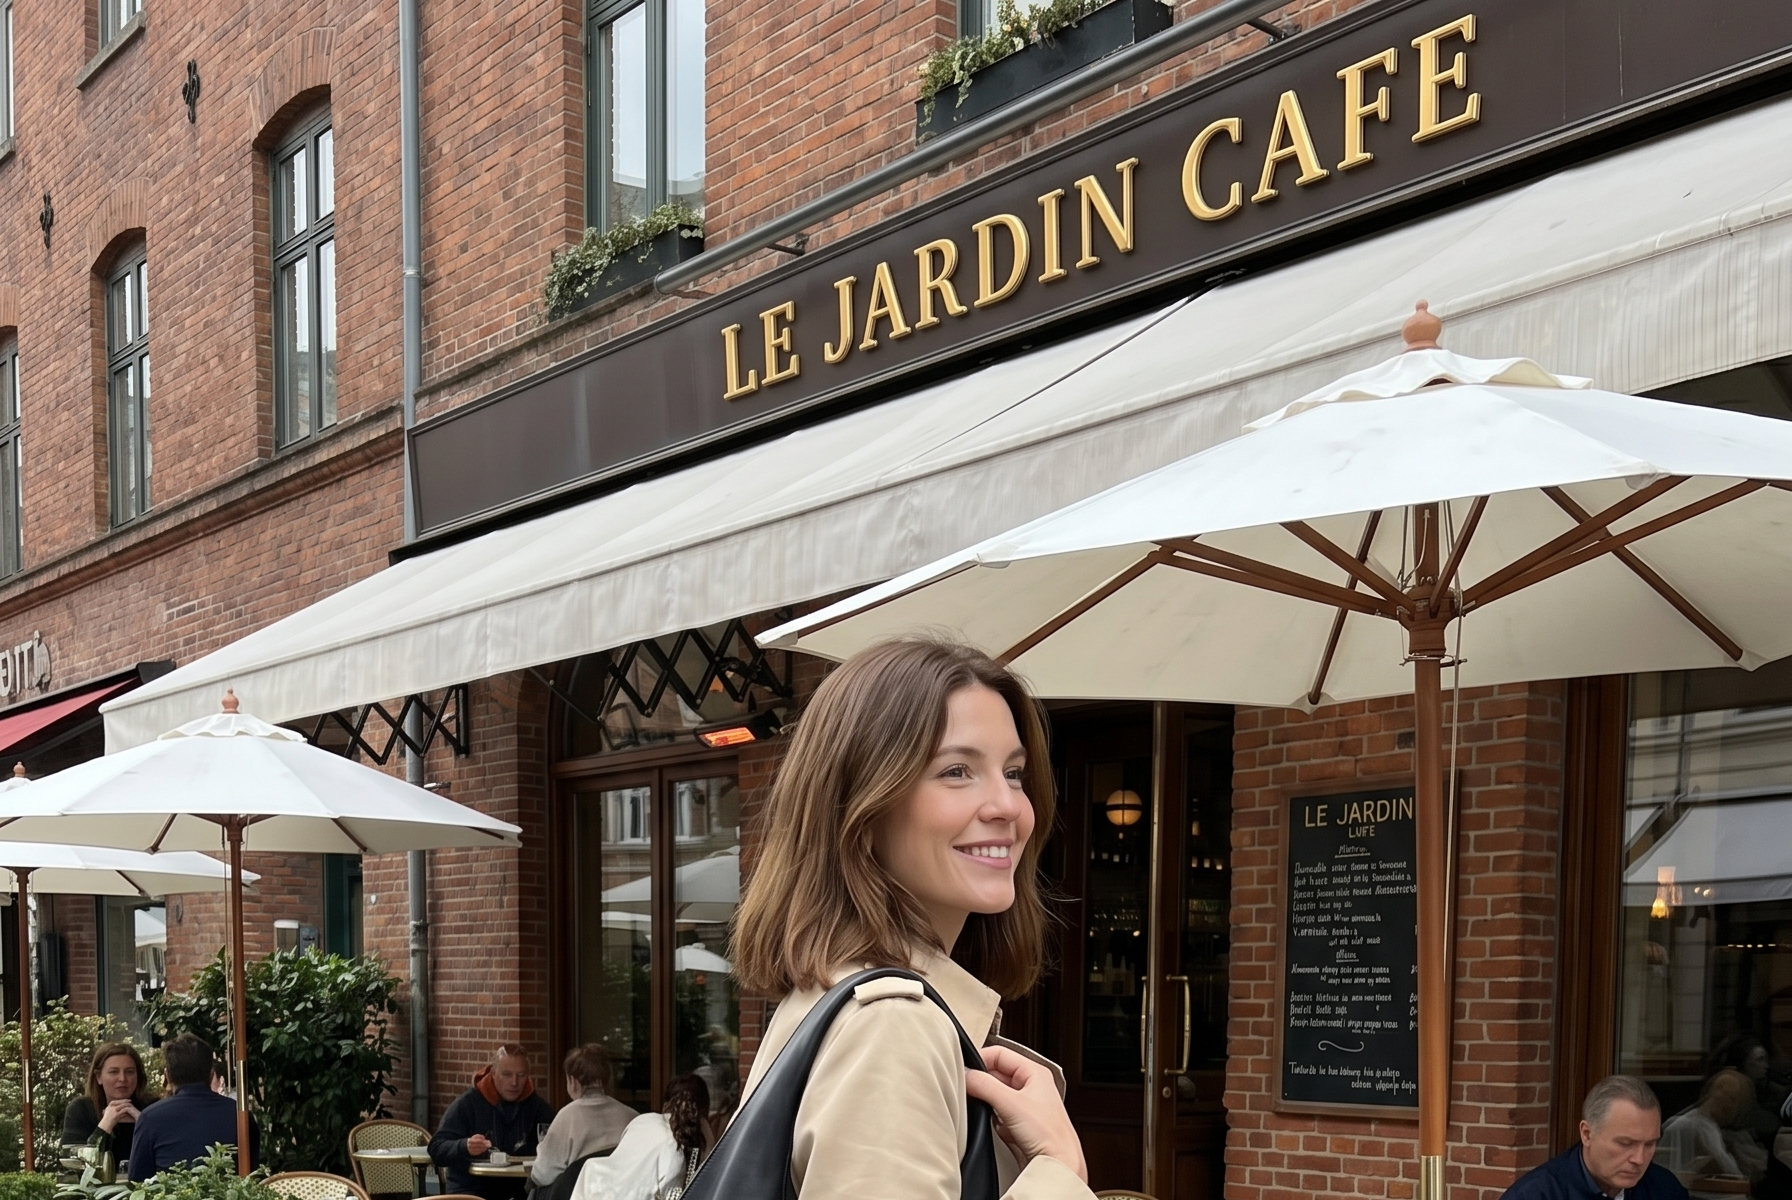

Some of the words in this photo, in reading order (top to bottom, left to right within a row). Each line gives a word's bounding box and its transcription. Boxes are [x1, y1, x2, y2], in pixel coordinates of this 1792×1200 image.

[722, 300, 801, 400] LE
[824, 157, 1140, 364] JARDIN
[1181, 14, 1482, 221] CAFE
[1304, 804, 1329, 828] LE
[1336, 797, 1414, 825] JARDIN
